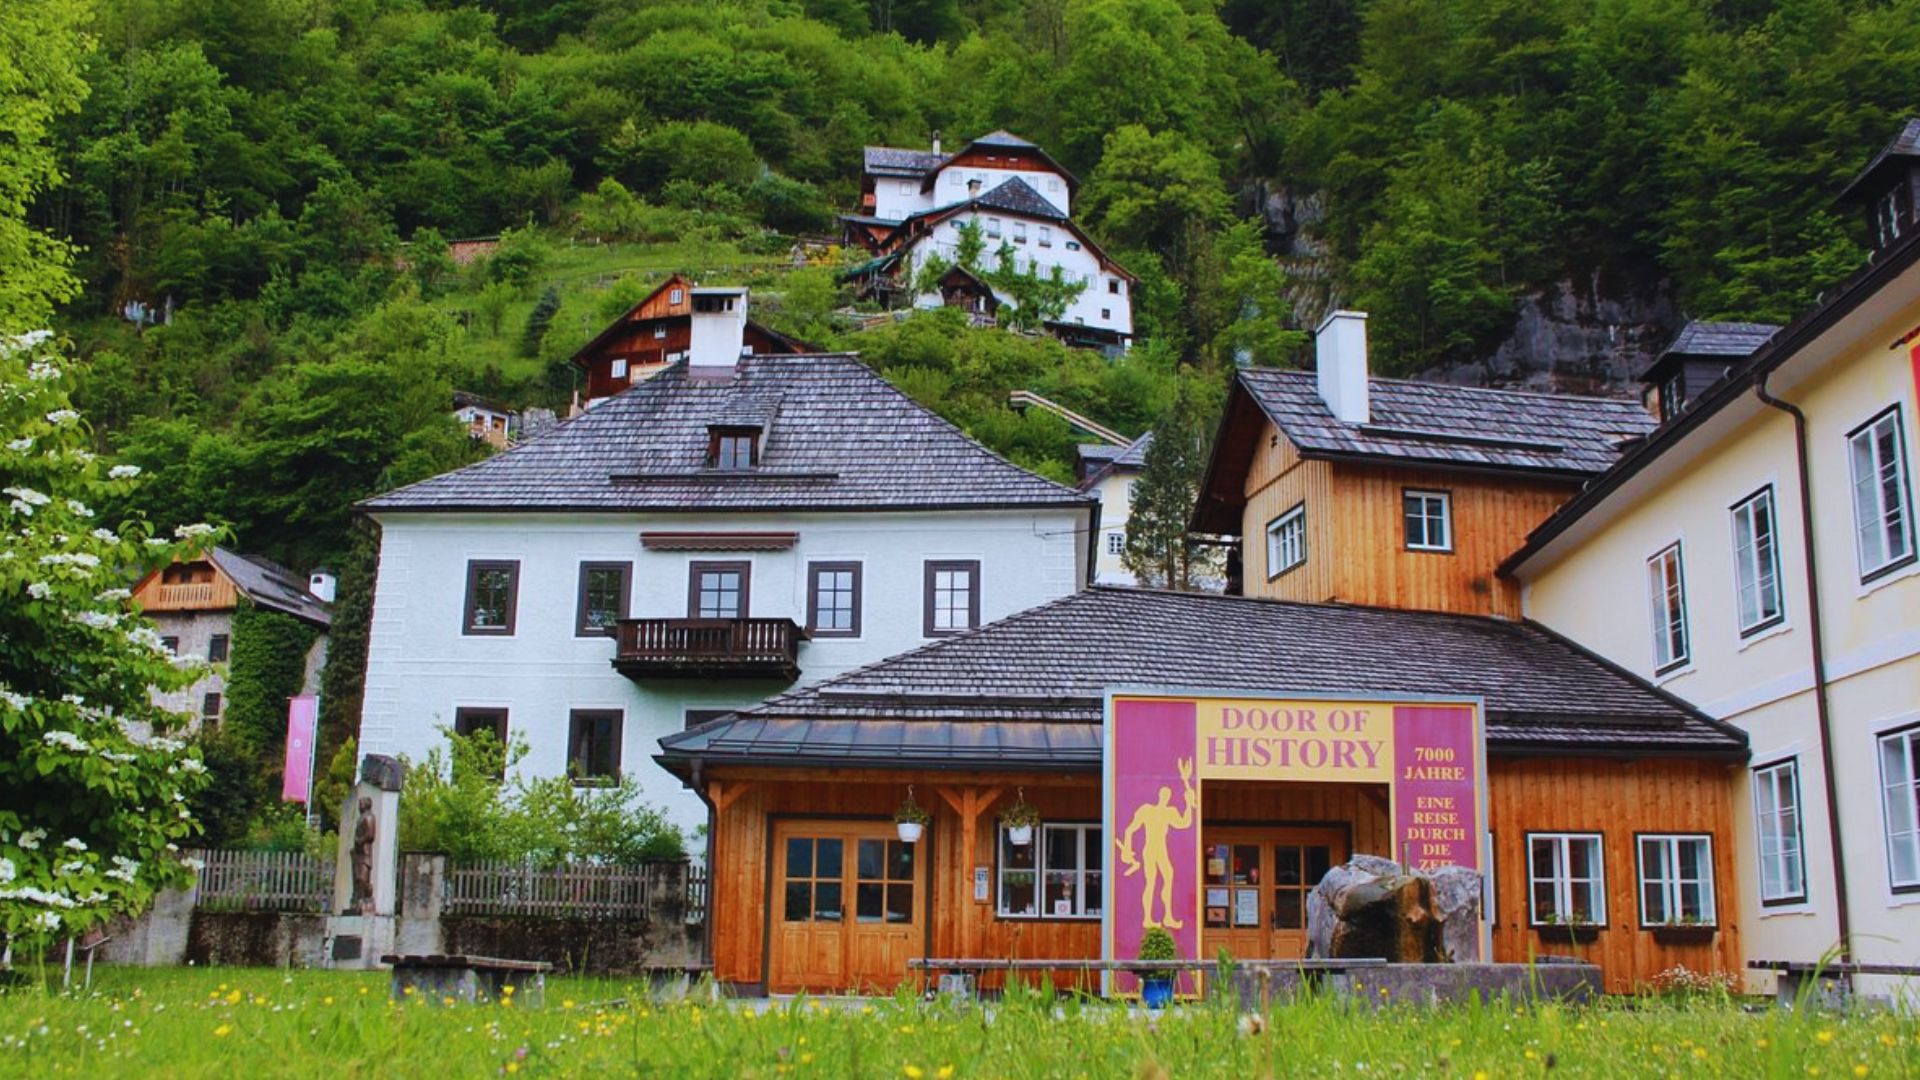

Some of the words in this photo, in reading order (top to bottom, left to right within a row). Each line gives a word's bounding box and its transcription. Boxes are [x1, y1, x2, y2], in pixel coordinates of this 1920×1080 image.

[1221, 708, 1317, 732] DOOR
[1327, 709, 1371, 733] OF
[1206, 736, 1386, 769] HISTORY
[1414, 747, 1455, 762] 7000
[1404, 766, 1465, 781] JAHRE
[1417, 797, 1455, 810] EINE
[1413, 812, 1459, 825] REISE
[1407, 828, 1466, 841] DURCH
[1423, 843, 1452, 856] DIE
